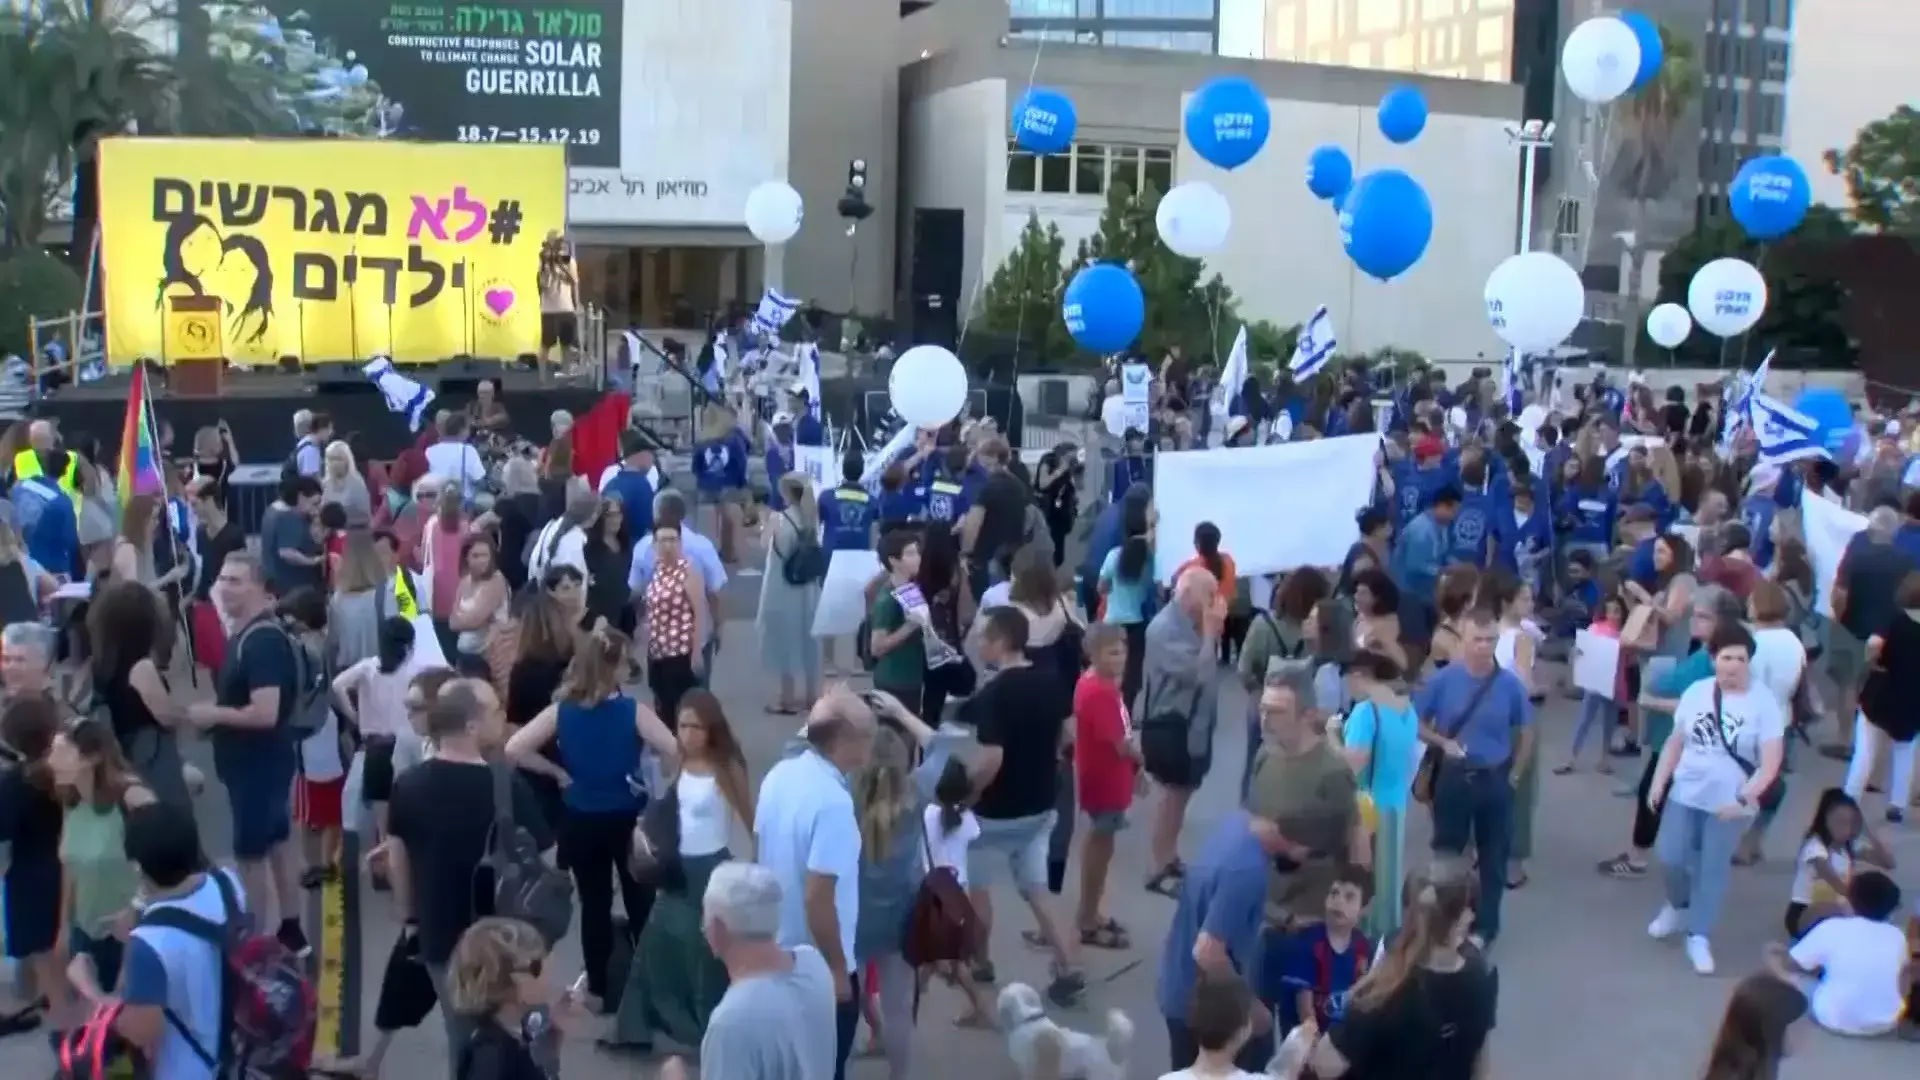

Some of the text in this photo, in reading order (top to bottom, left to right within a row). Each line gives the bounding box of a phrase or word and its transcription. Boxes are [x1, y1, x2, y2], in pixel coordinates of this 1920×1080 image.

[387, 34, 461, 48] CONSTRUCTIVE
[525, 39, 602, 68] SOLAR
[420, 50, 520, 65] TO CLIMATE CHANGE
[465, 67, 601, 97] GUERRILLA
[620, 174, 645, 198] תל
[656, 180, 708, 200] מוזיאון
[152, 177, 388, 236] מגרשים
[293, 244, 465, 308] ילדים
